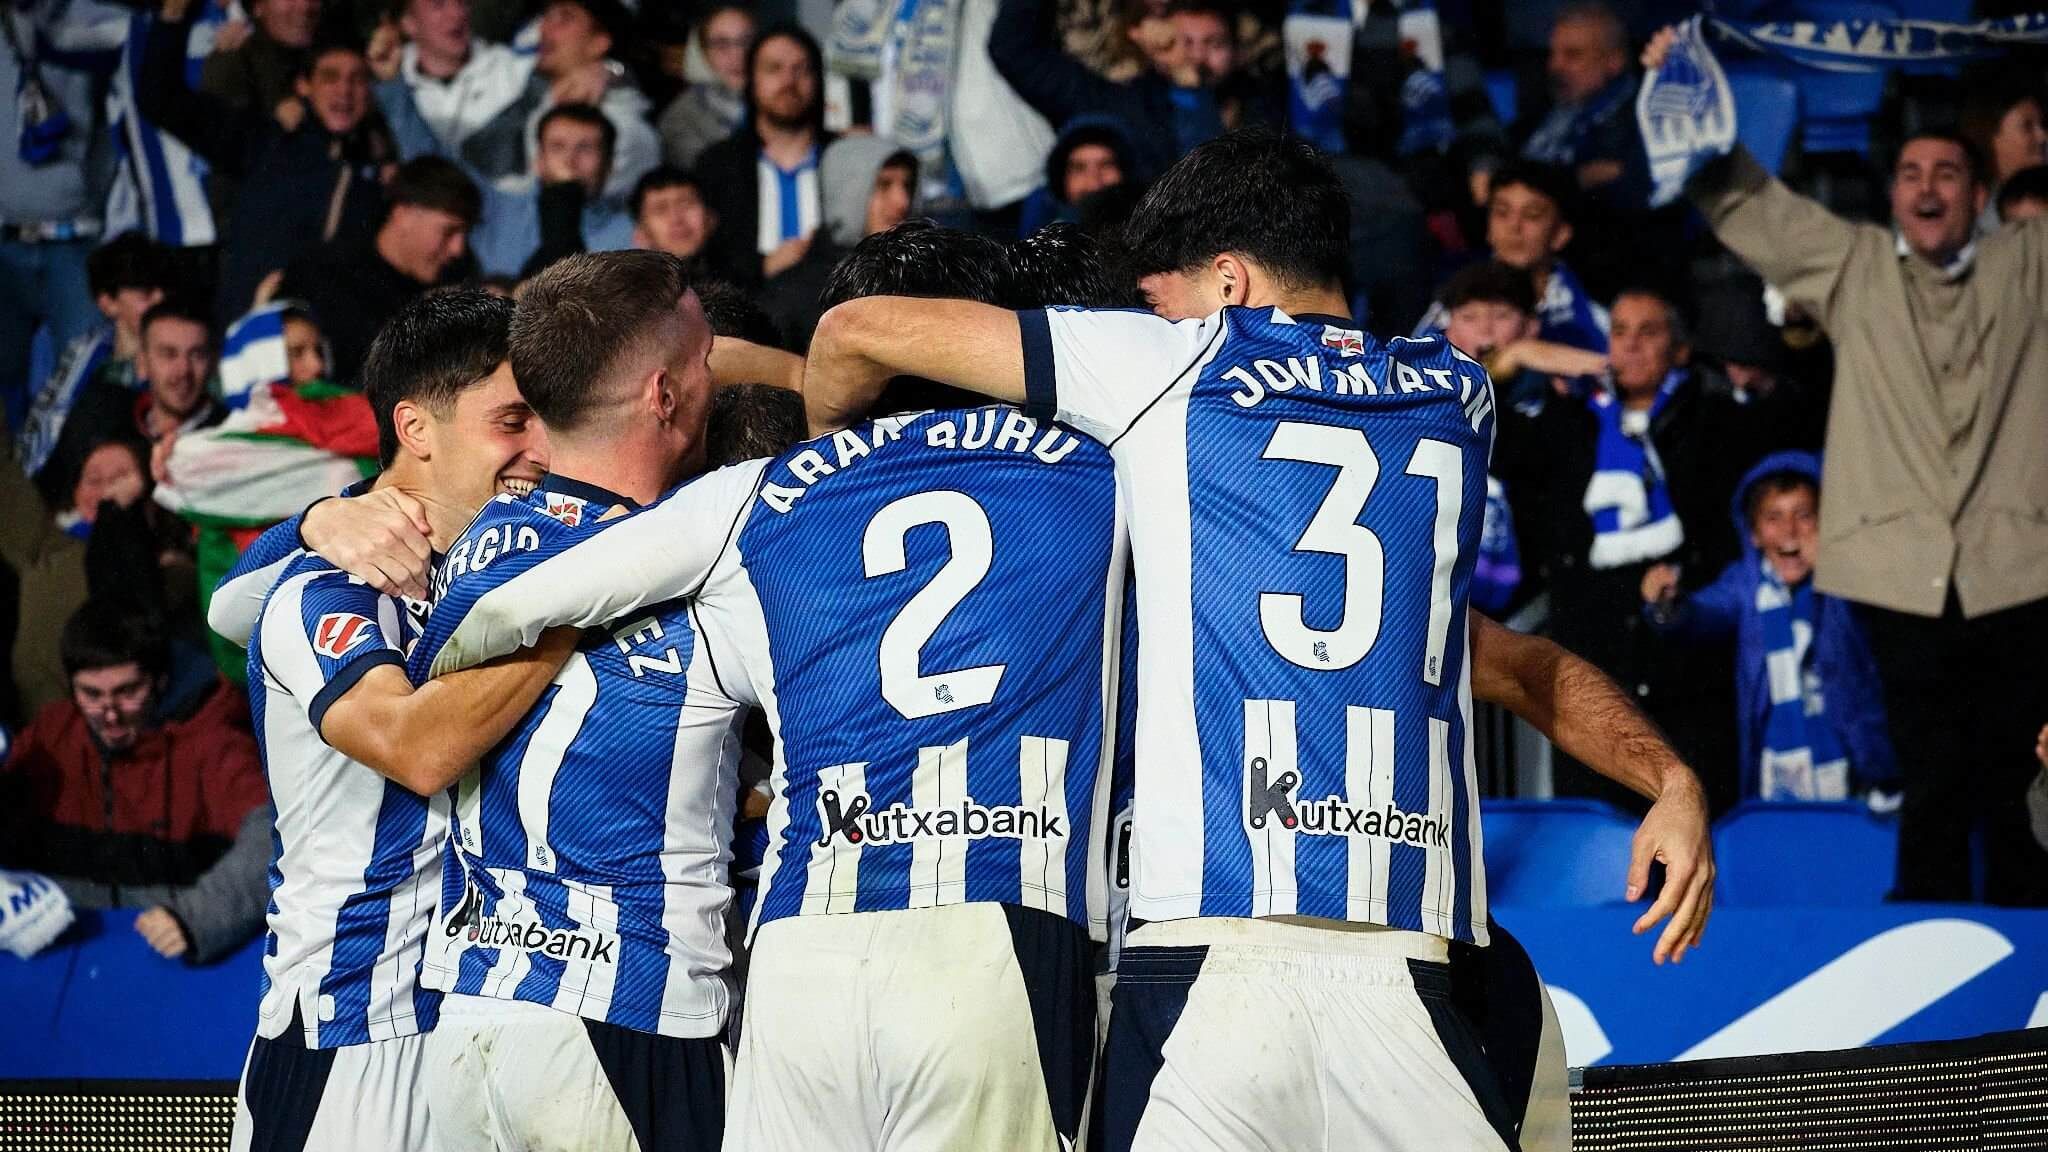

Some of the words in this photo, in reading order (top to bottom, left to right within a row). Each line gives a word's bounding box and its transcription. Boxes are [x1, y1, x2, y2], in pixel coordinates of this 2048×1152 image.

[1221, 356, 1323, 408] JON
[1259, 421, 1463, 687] 31
[862, 489, 1007, 720] 2
[818, 789, 1064, 848] Kutxabank
[1250, 756, 1450, 848] Kutxabank
